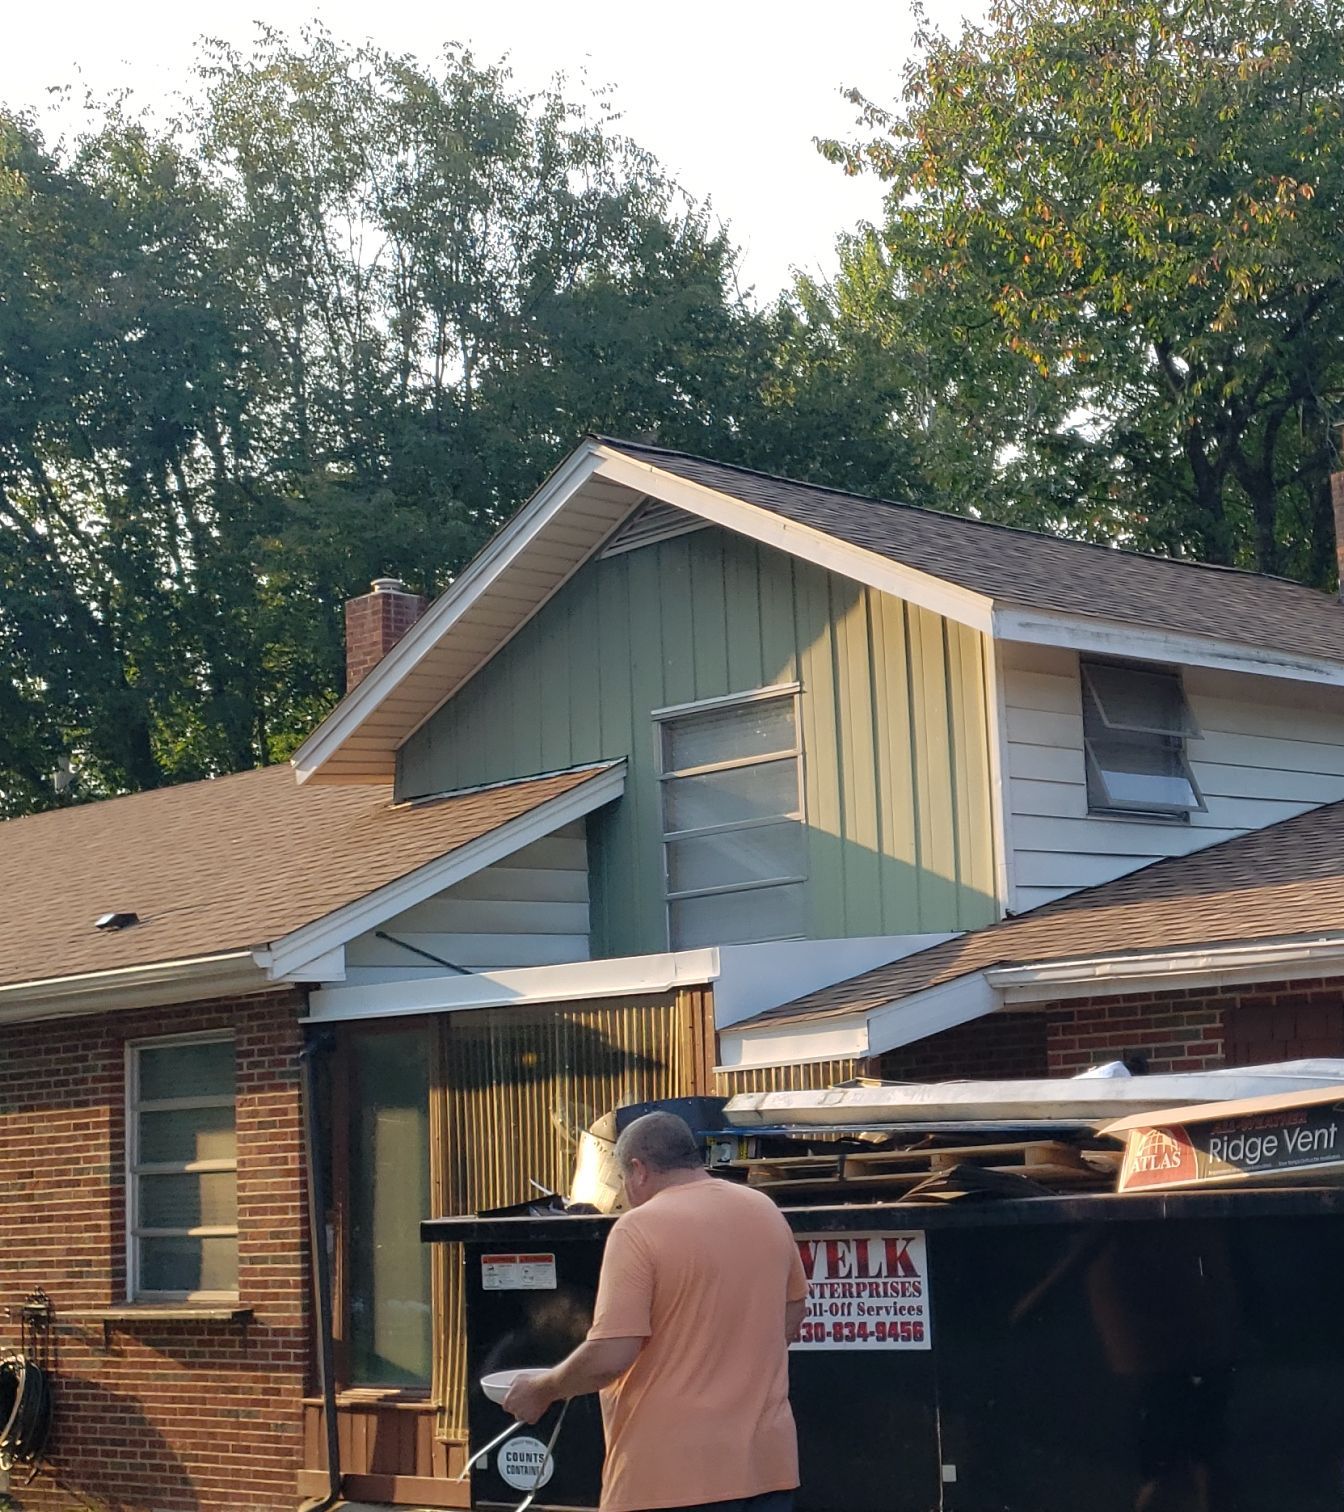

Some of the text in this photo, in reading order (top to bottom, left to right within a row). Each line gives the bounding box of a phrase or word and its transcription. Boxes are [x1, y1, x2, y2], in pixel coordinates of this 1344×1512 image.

[1209, 1134, 1278, 1165] Ridge
[1283, 1122, 1338, 1154] Vent
[1132, 1151, 1181, 1173] ATLAS
[806, 1280, 922, 1300] NTERPRISES
[804, 1301, 923, 1317] oll-Off Services
[800, 1320, 924, 1343] 30-834-9456
[506, 1451, 545, 1464] COUNTS
[506, 1464, 543, 1476] CONTAIN
